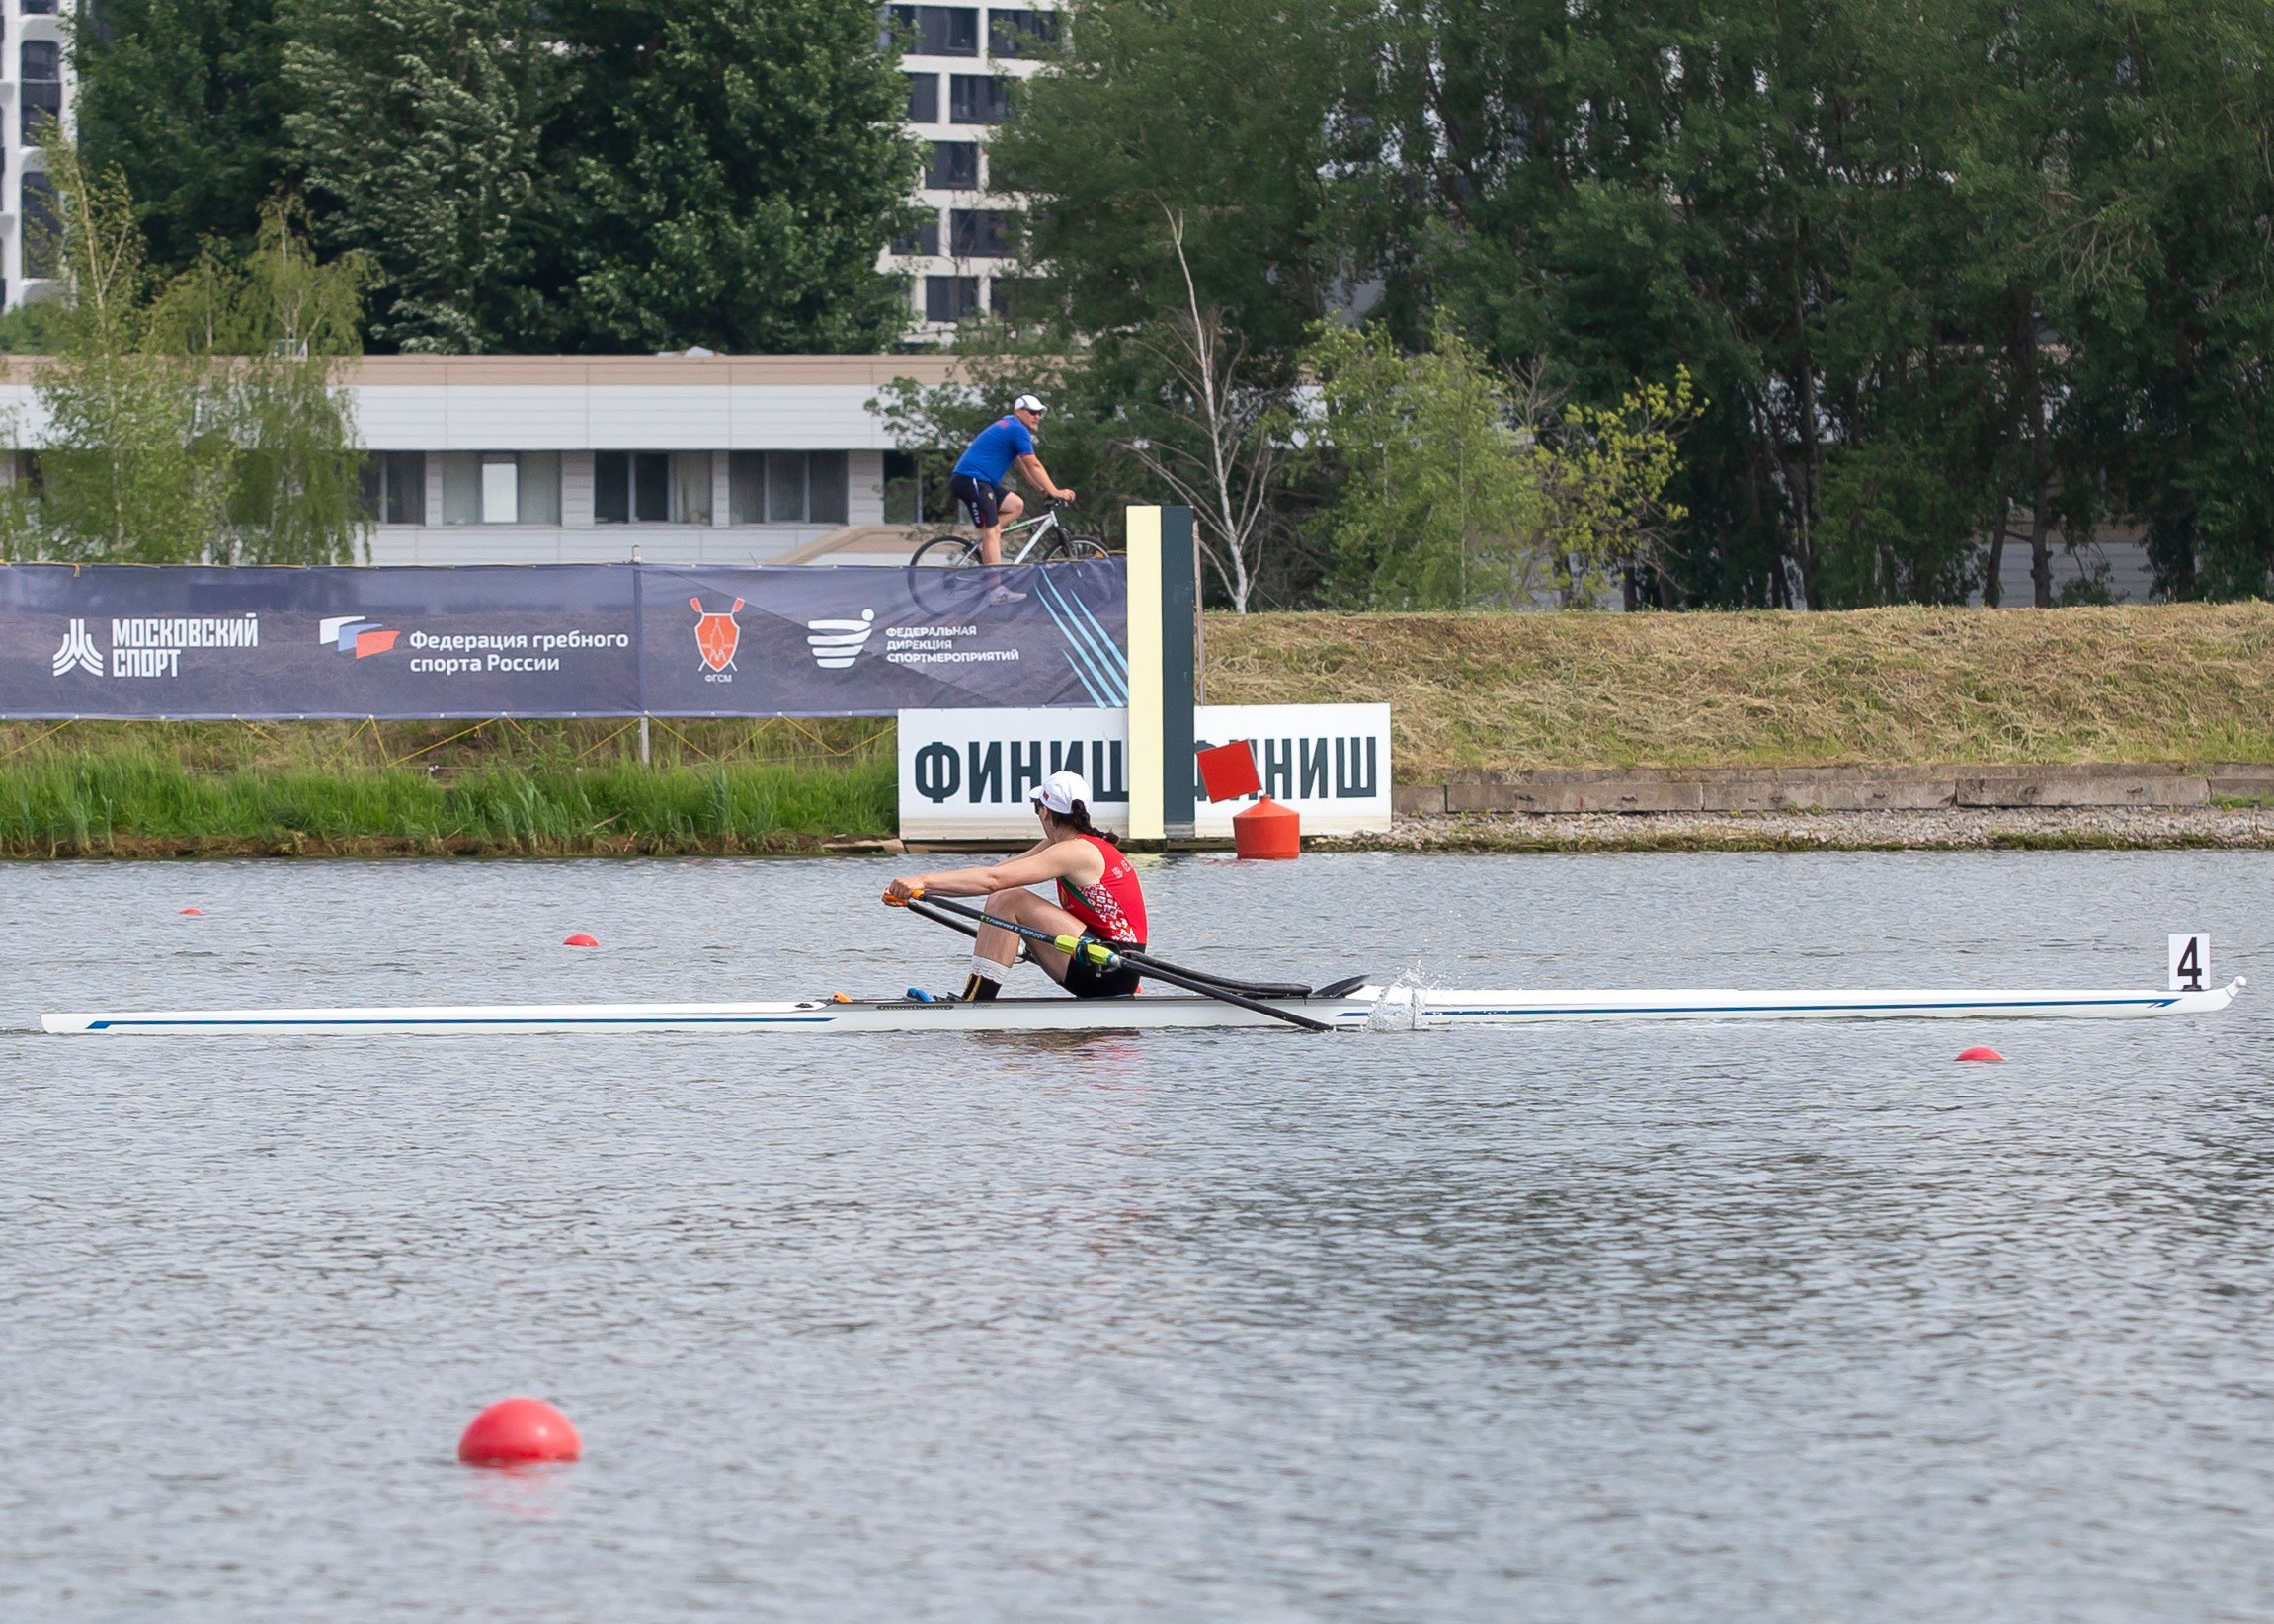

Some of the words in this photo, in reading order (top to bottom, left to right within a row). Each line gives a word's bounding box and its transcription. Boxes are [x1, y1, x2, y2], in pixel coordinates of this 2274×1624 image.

[112, 612, 258, 647] МОСКОВСКИЙ
[885, 625, 977, 637] ФЕДЕРАЛЬНАЯ
[409, 630, 528, 652] Федерация
[533, 630, 629, 652] гребного
[886, 640, 953, 651] ДИРЕКЦИЯ
[113, 649, 181, 677] СПОРТ
[409, 656, 482, 675] спорта
[486, 654, 560, 672] России
[886, 649, 1019, 663] СПОРТМЕРОПРИЯТИЙ
[704, 674, 733, 683] ФГСМ
[1194, 737, 1376, 801] НИШ
[2177, 936, 2202, 989] 4
